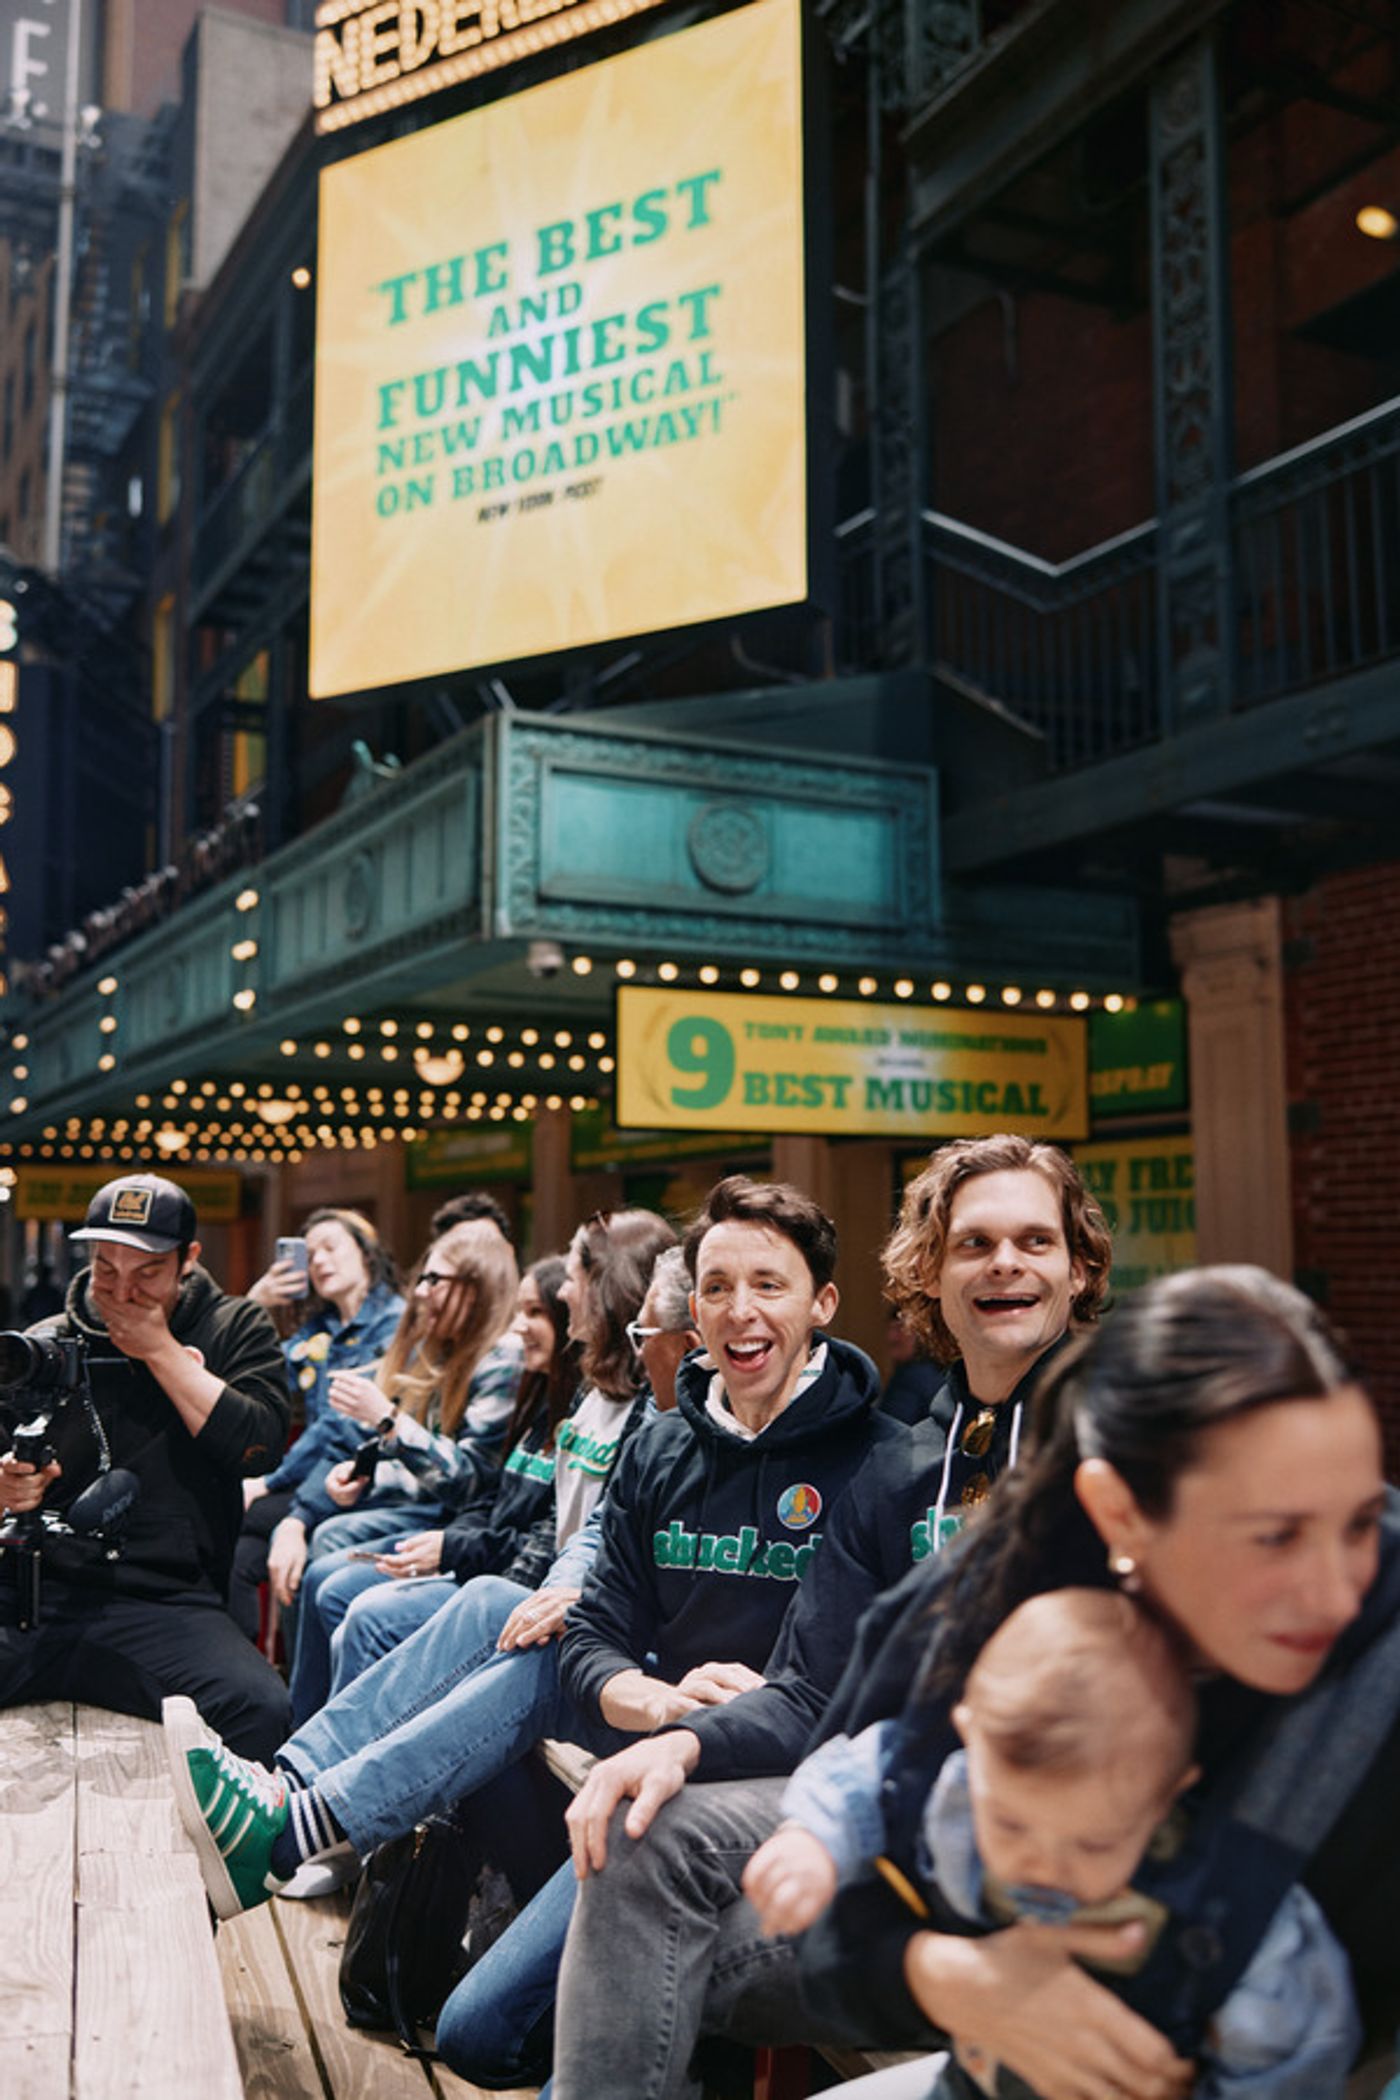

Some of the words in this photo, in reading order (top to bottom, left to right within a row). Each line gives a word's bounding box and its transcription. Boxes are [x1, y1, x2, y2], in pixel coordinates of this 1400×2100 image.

[379, 241, 508, 326] THE
[535, 168, 722, 277] BEST
[375, 283, 722, 431] FUNNIEST
[487, 281, 583, 338] AND
[375, 416, 482, 475] NEW
[501, 349, 723, 440] MUSICAL
[375, 474, 435, 519] ON
[666, 1015, 736, 1111] 9
[742, 1070, 854, 1109] BEST
[865, 1078, 1050, 1117] MUSICAL
